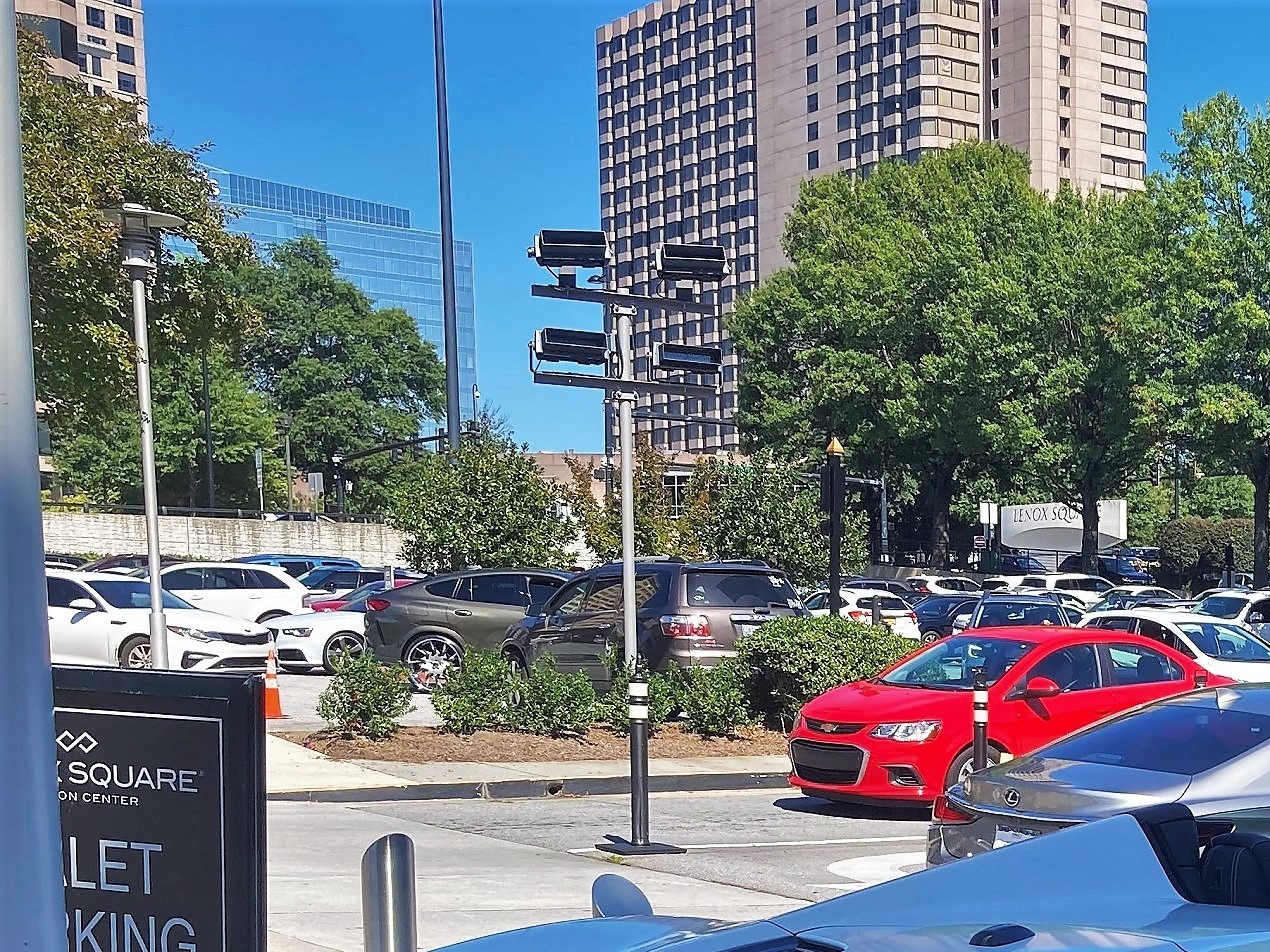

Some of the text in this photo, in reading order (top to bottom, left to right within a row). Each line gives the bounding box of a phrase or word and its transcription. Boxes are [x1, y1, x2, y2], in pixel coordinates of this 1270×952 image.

[1013, 506, 1048, 523] LENOX
[68, 761, 198, 794] SQUARE
[58, 790, 139, 806] ON CENTER
[64, 836, 163, 895] LET
